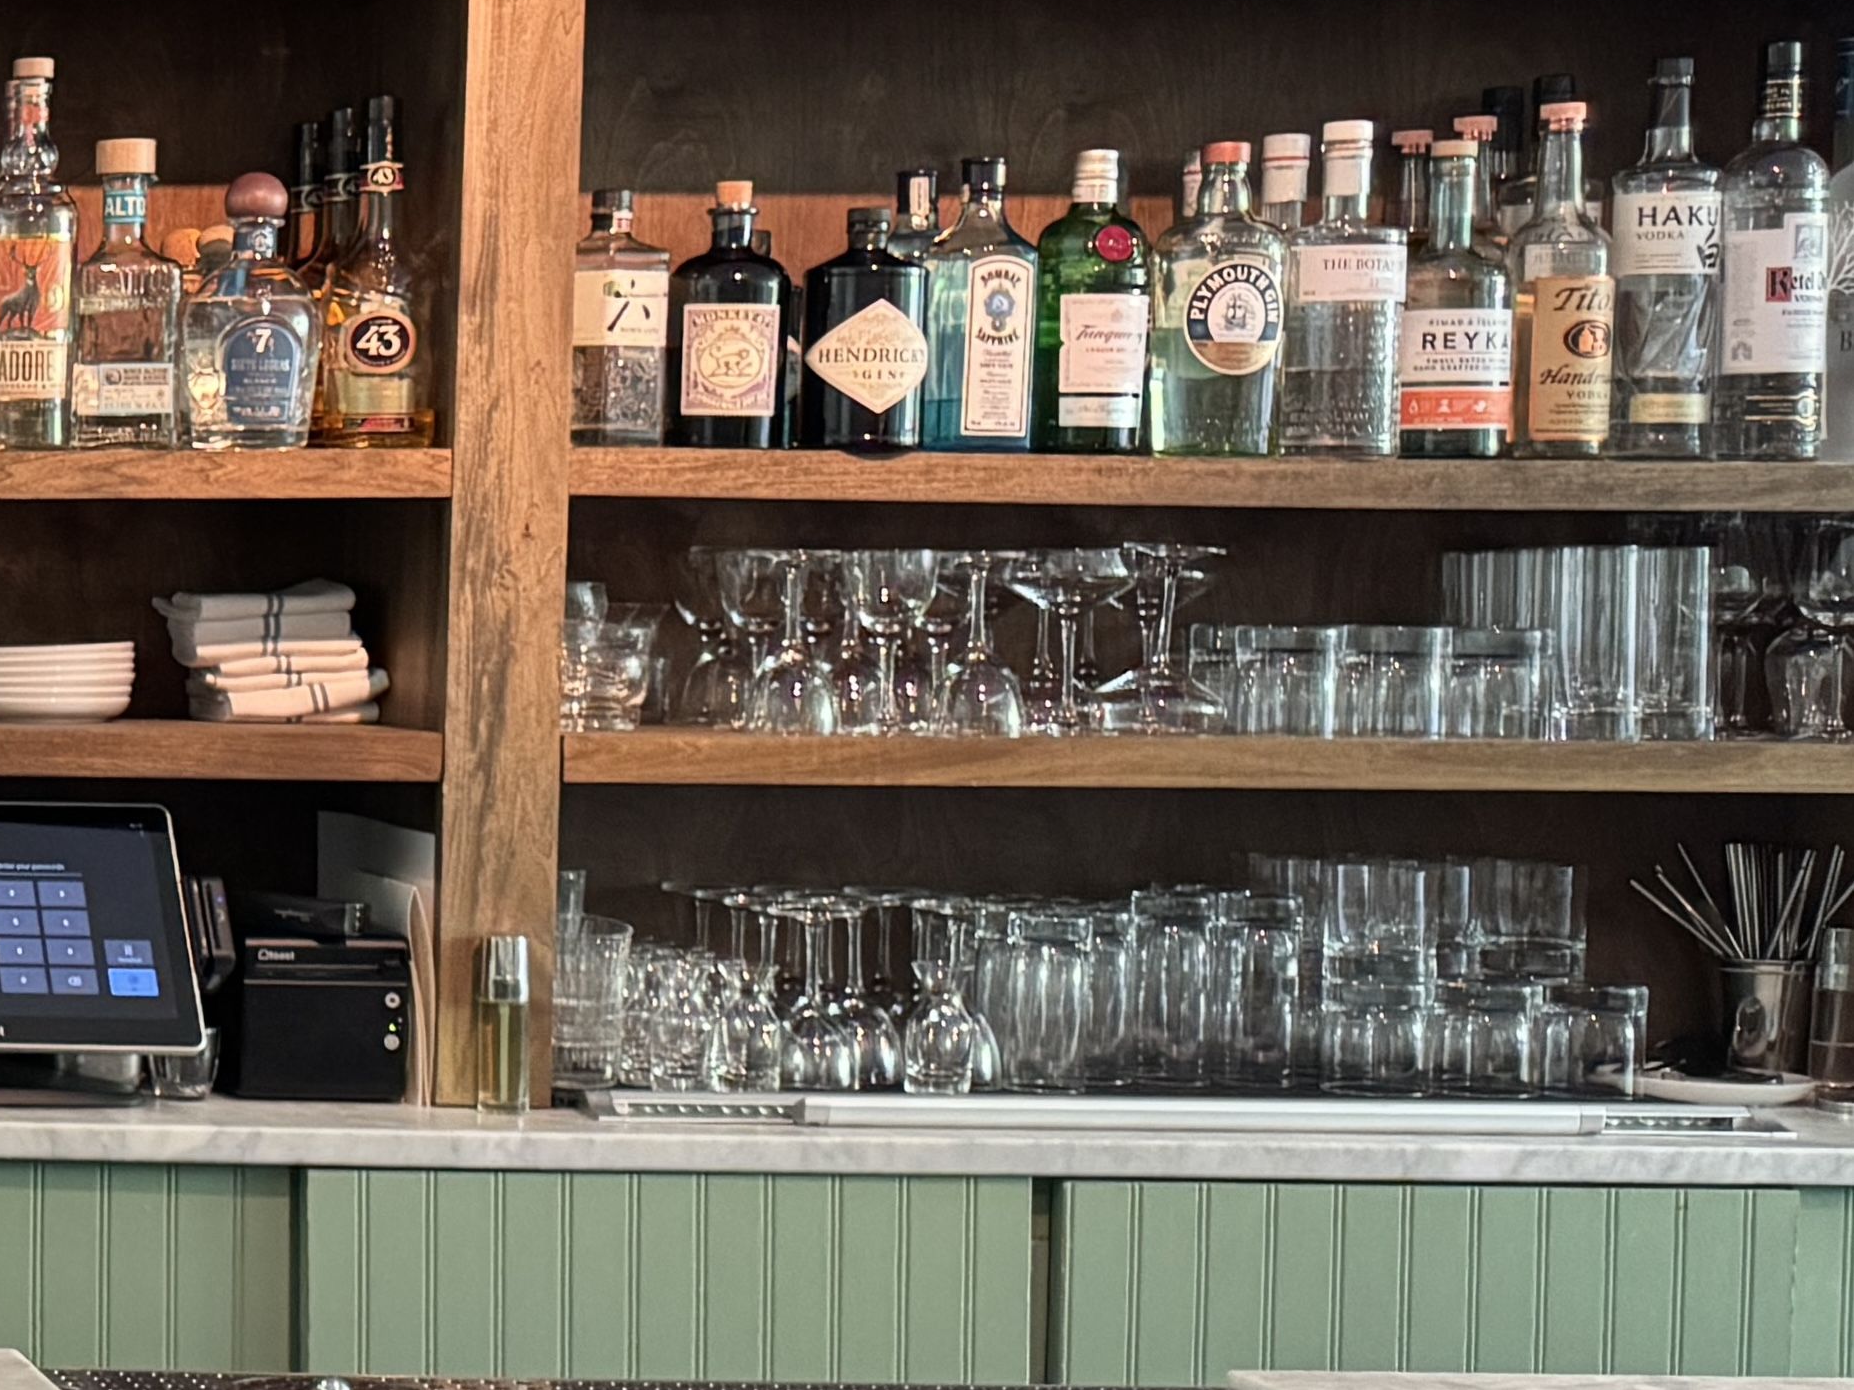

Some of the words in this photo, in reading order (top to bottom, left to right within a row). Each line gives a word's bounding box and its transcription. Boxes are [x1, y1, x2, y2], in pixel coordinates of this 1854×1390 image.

[1637, 205, 1717, 227] HAKU
[1636, 230, 1685, 241] VODKA
[1190, 265, 1267, 321] PLYMOUTH
[1265, 288, 1280, 324] GIN
[1554, 286, 1611, 312] Tito
[254, 329, 272, 353] 7
[355, 325, 403, 356] 43
